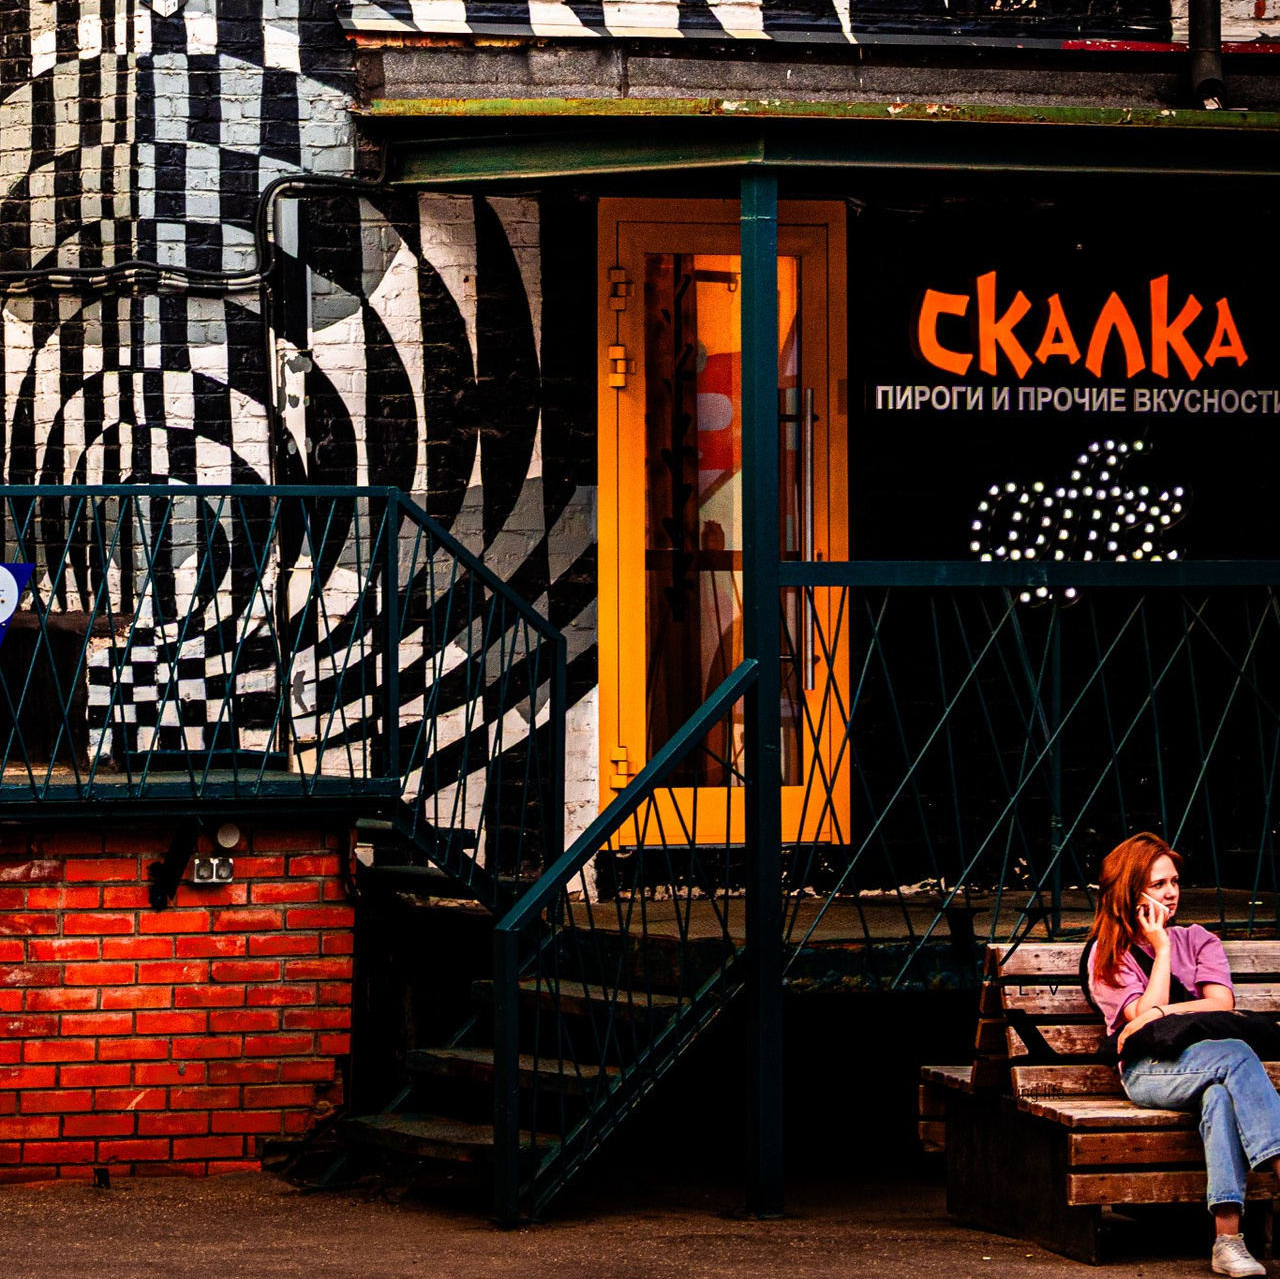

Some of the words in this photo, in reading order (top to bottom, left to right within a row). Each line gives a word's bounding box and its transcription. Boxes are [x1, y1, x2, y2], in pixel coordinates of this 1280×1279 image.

[876, 385, 984, 411] ПИРОГИ
[992, 386, 1010, 411] И
[1018, 386, 1126, 412] ПРОЧИЕ
